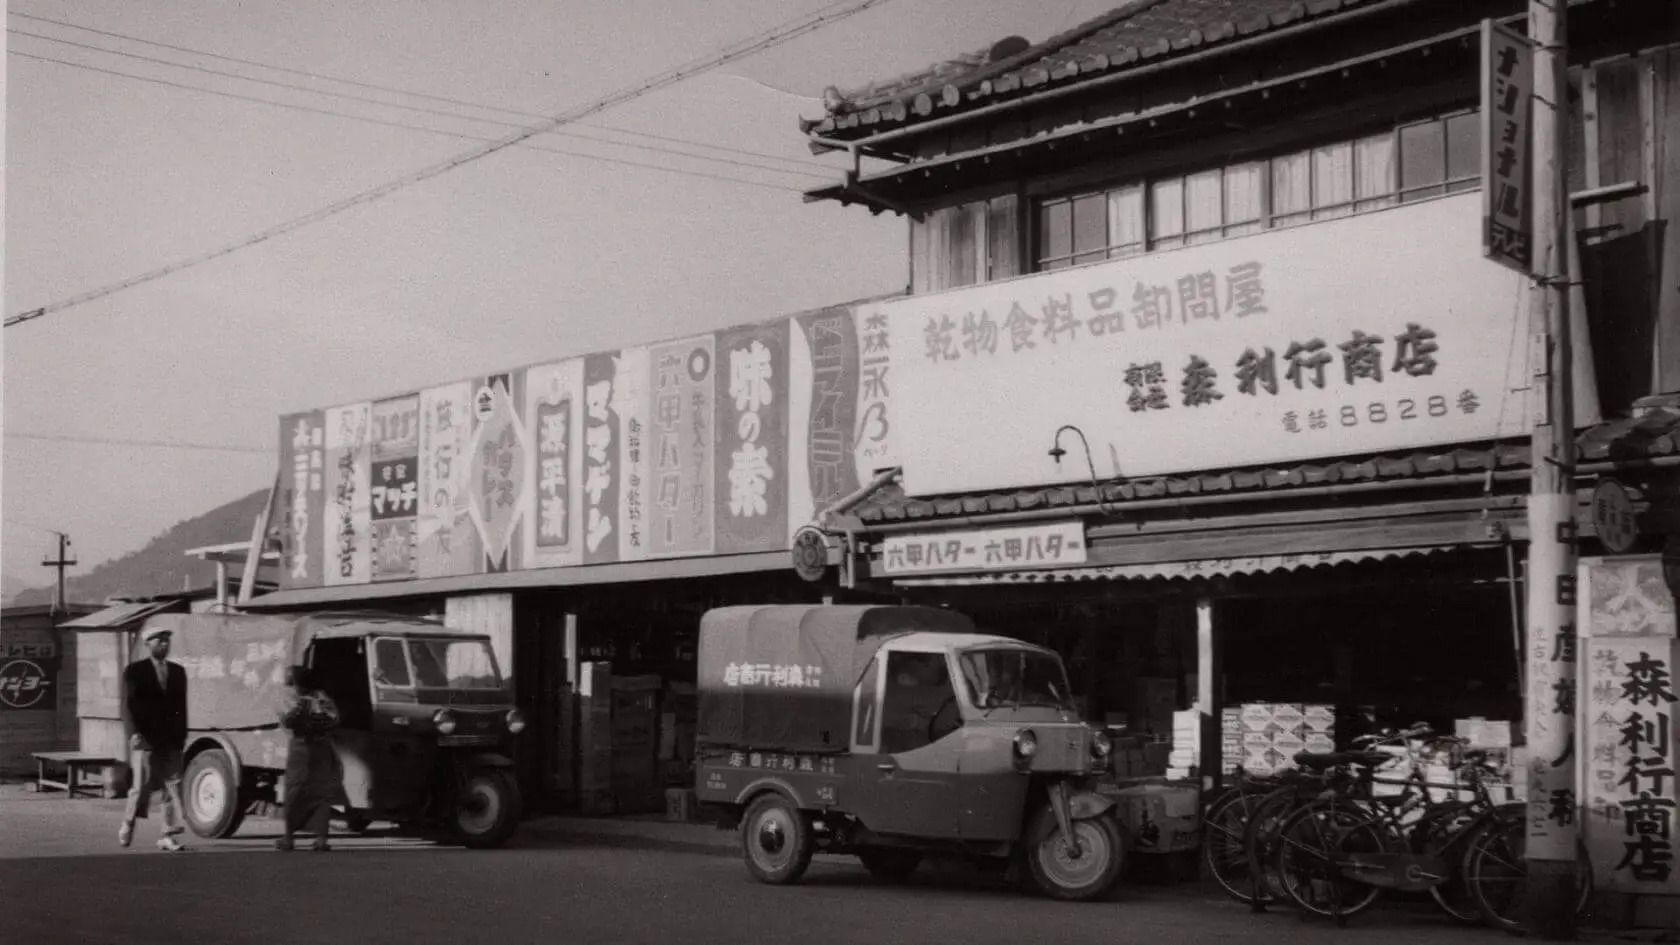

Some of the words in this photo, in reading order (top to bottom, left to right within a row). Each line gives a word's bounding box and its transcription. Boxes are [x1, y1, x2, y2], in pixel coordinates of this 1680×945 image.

[1495, 45, 1519, 219] ナショナル
[923, 260, 1268, 364] 乾物食料品卸問屋
[1181, 322, 1440, 407] 森利行商店
[729, 339, 774, 516] 味の素
[1617, 651, 1678, 882] 森利行商店
